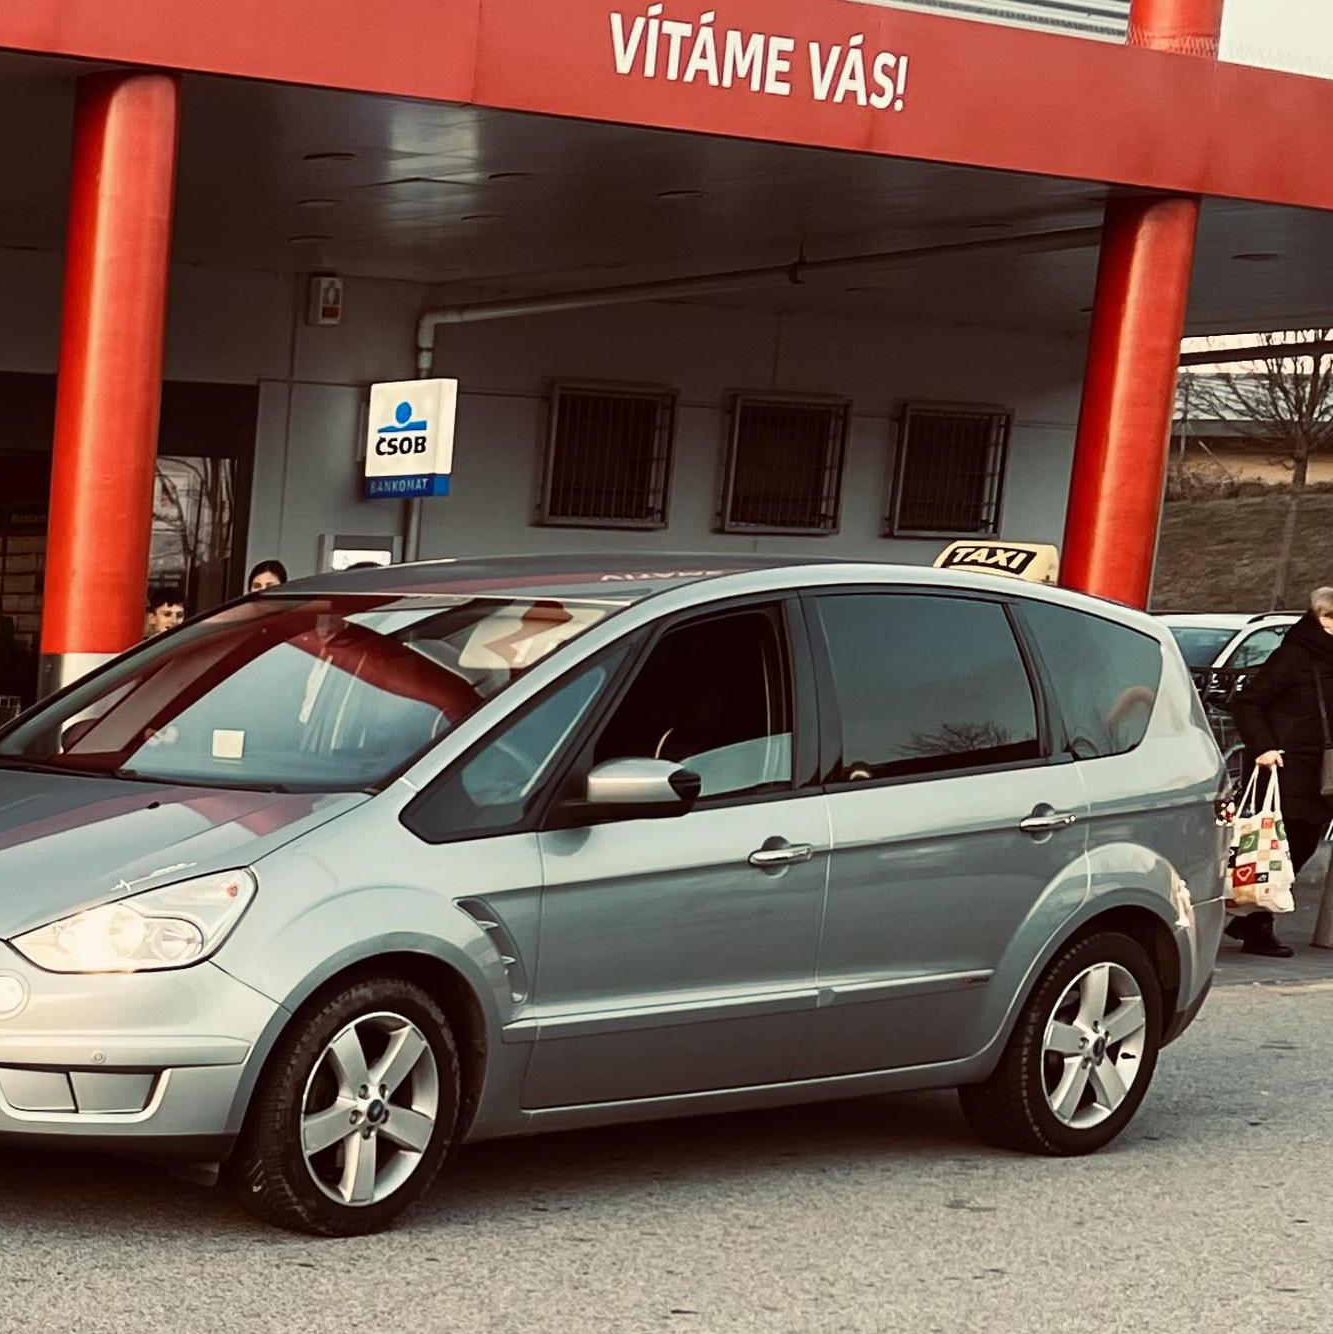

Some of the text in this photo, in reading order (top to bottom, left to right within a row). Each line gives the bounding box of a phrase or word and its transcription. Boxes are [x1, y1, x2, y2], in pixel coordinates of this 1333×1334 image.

[609, 2, 909, 112] VÍTÁME VÁS!
[375, 436, 427, 456] ČSOB
[370, 478, 429, 494] BANKOMAT
[952, 547, 1028, 569] TAXI
